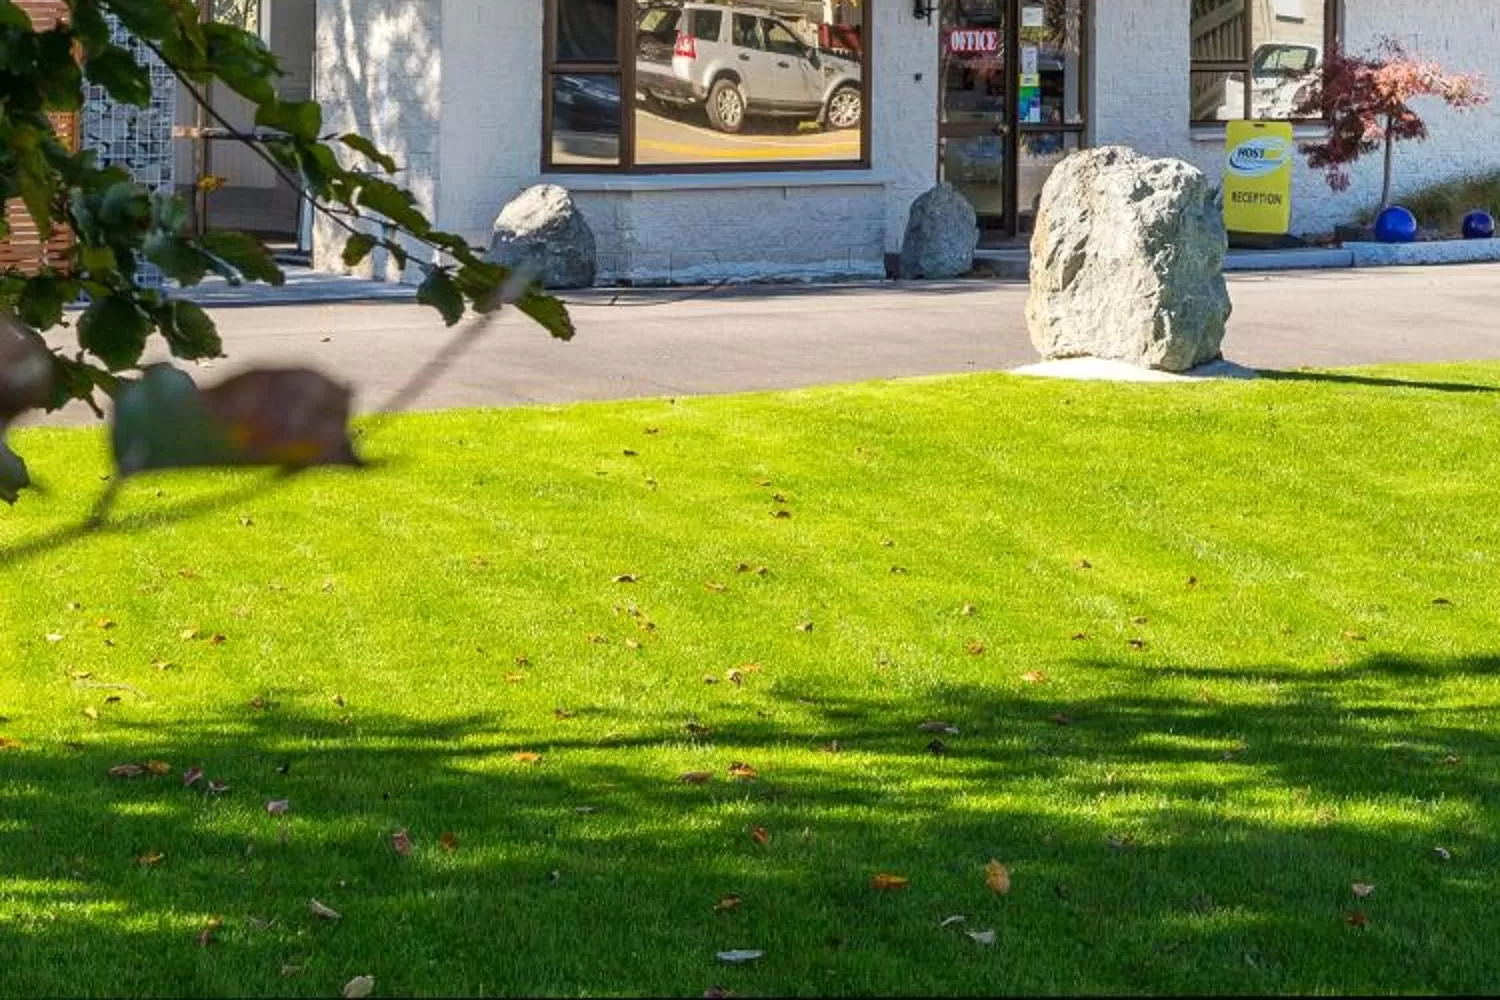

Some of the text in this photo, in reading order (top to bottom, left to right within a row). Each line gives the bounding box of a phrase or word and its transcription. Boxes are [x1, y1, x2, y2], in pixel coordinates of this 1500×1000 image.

[951, 30, 997, 51] OFFICE
[1237, 147, 1265, 159] HOST
[1231, 191, 1282, 205] RECEPTION
